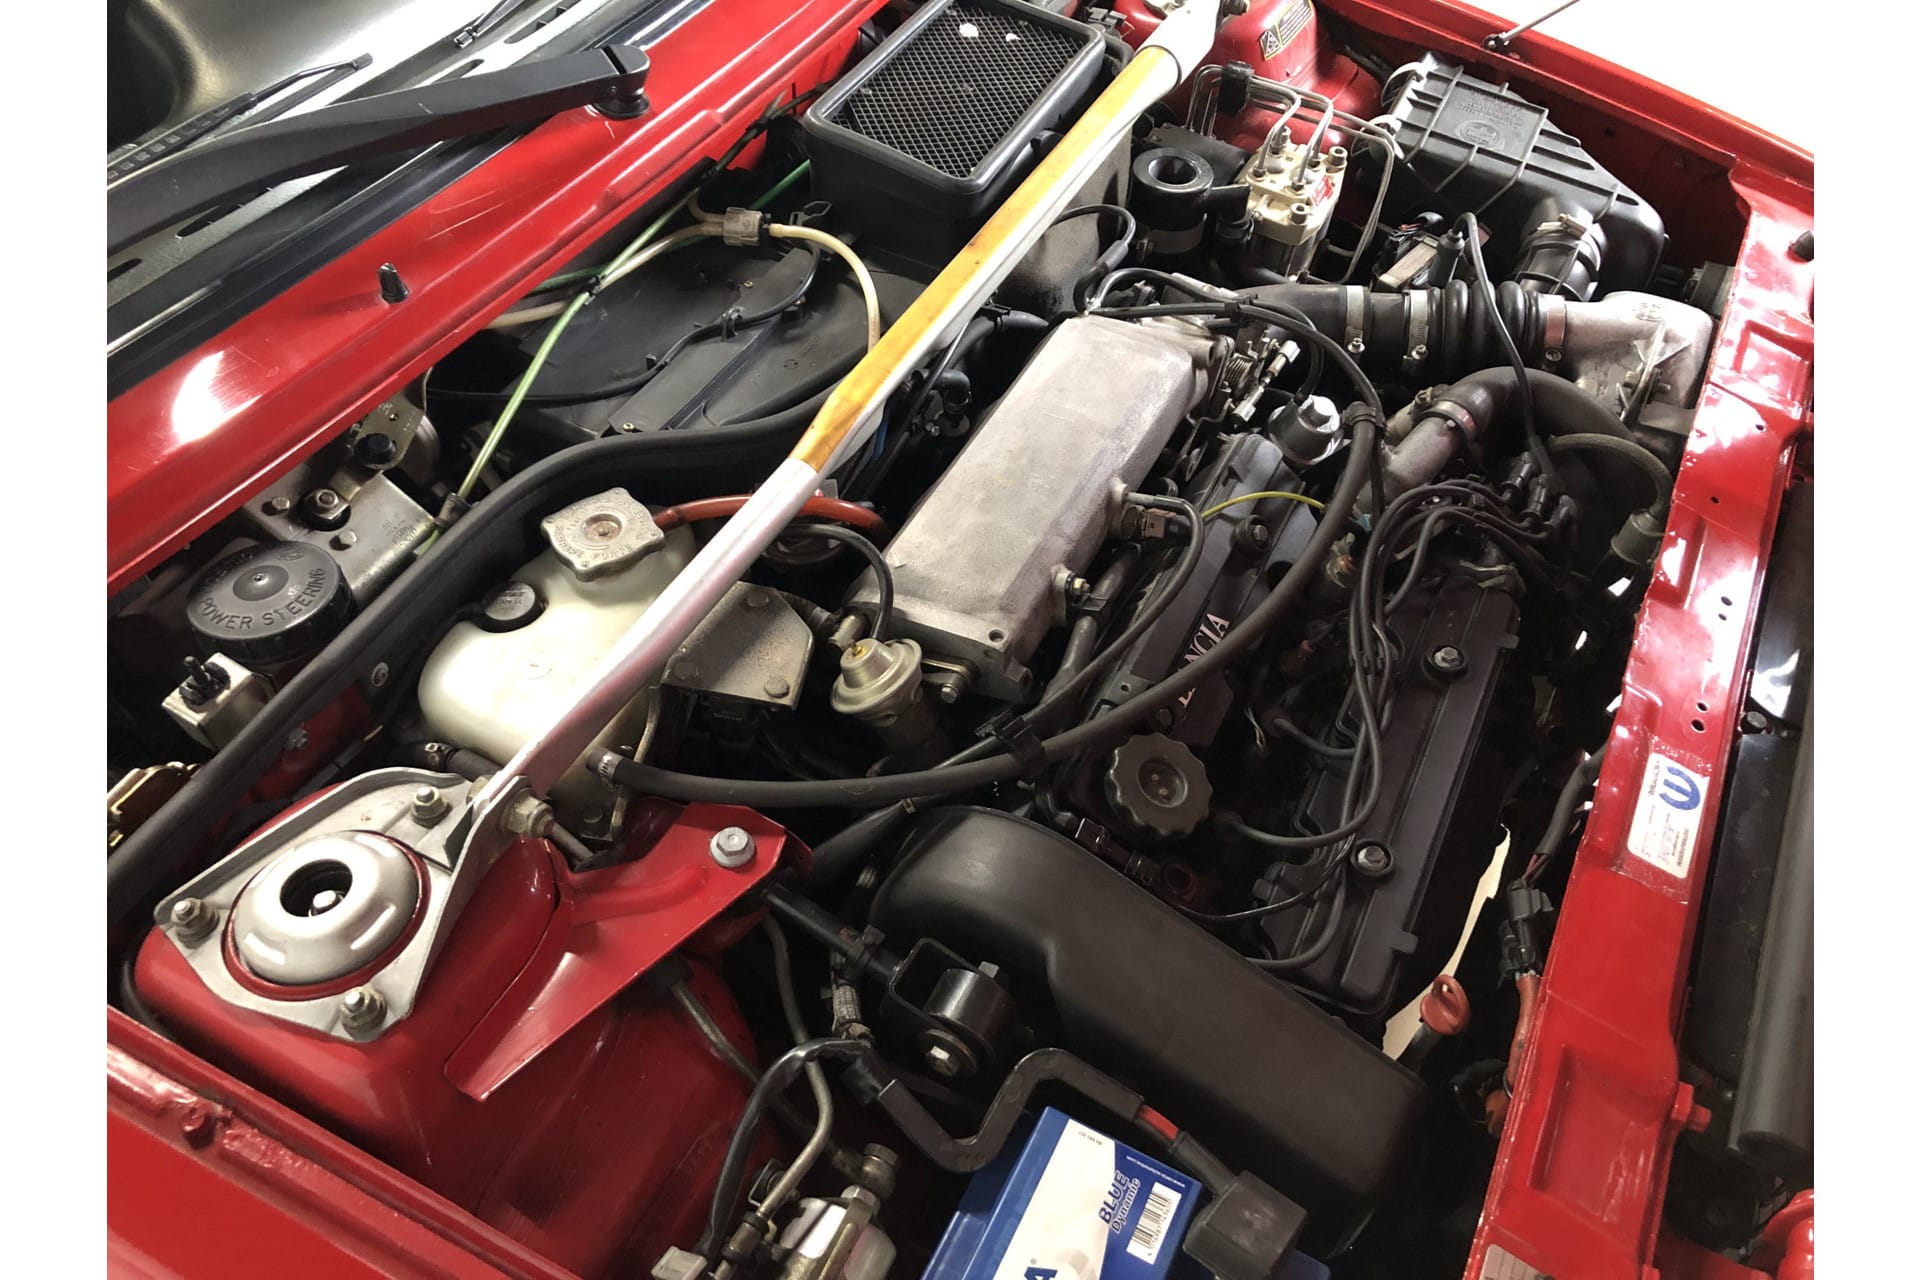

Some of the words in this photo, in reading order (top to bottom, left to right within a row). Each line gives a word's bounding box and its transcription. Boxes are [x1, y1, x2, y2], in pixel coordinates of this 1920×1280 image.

[201, 597, 253, 630] POWER
[261, 567, 328, 626] STEERING
[1099, 1169, 1129, 1225] BLUE
[1111, 1178, 1140, 1233] Dynamic
